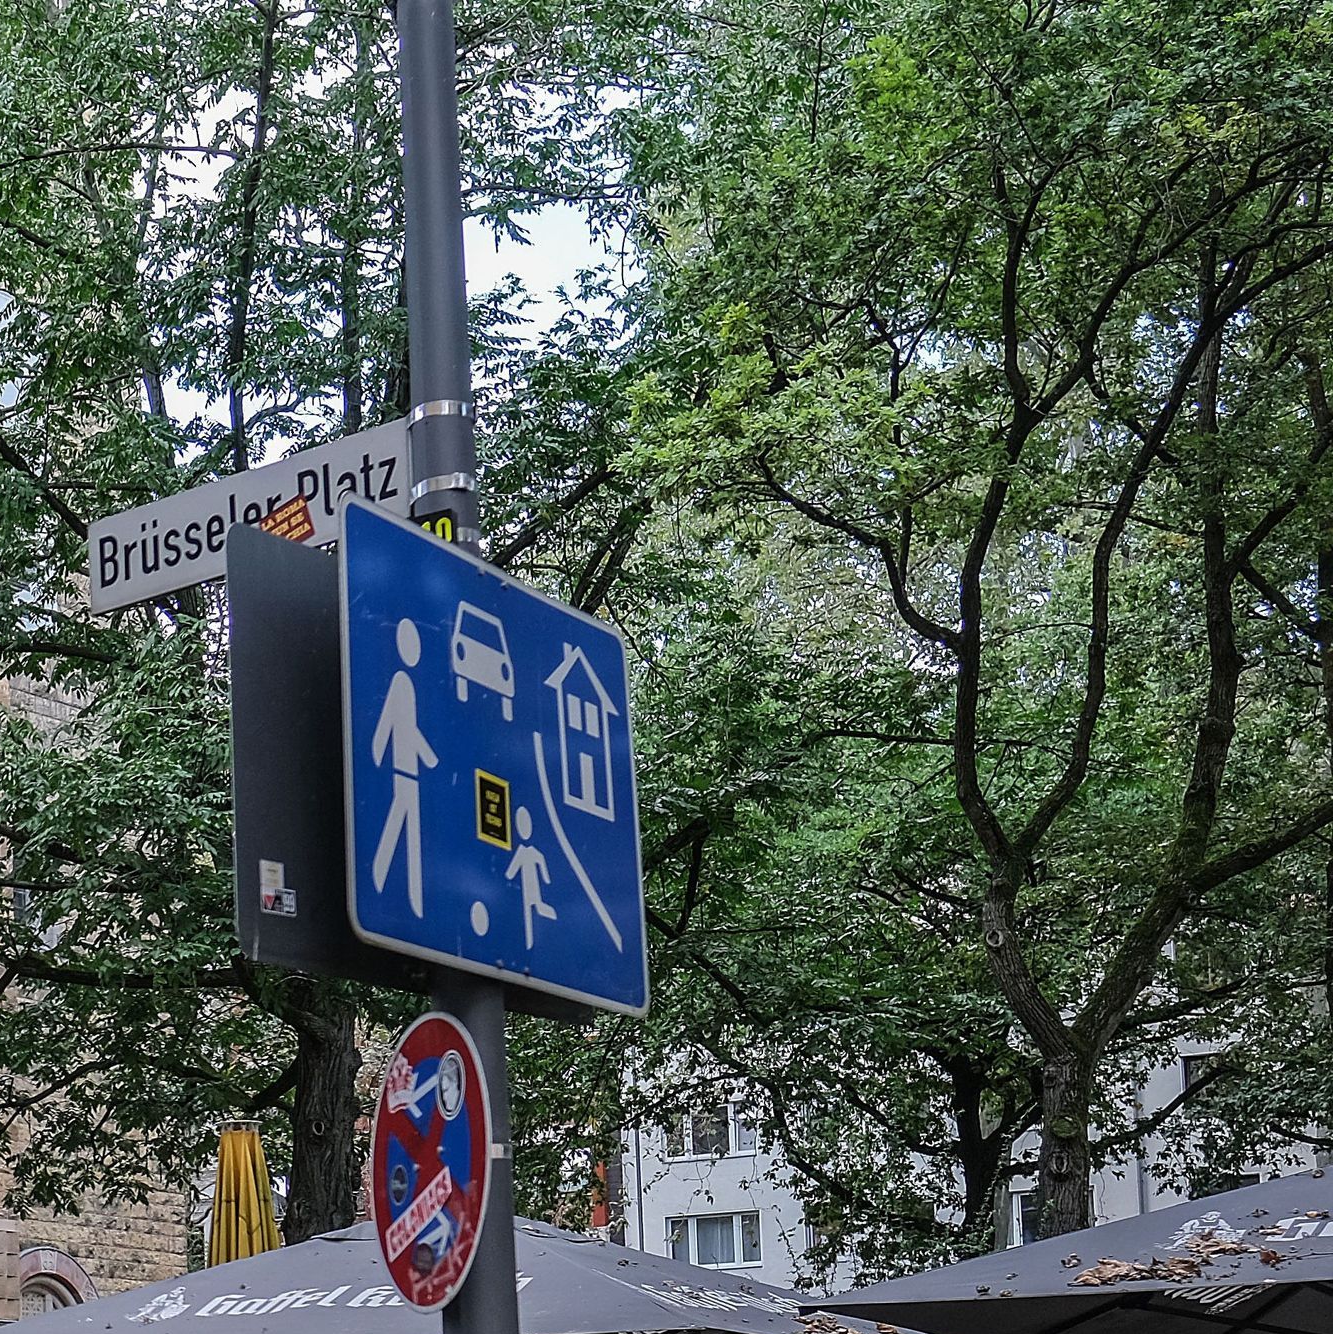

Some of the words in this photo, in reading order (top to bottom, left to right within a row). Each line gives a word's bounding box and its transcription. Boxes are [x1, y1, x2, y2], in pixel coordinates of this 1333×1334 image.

[98, 492, 282, 589] Brüsseler
[297, 452, 400, 516] Platz
[194, 1284, 352, 1317] Gaffel
